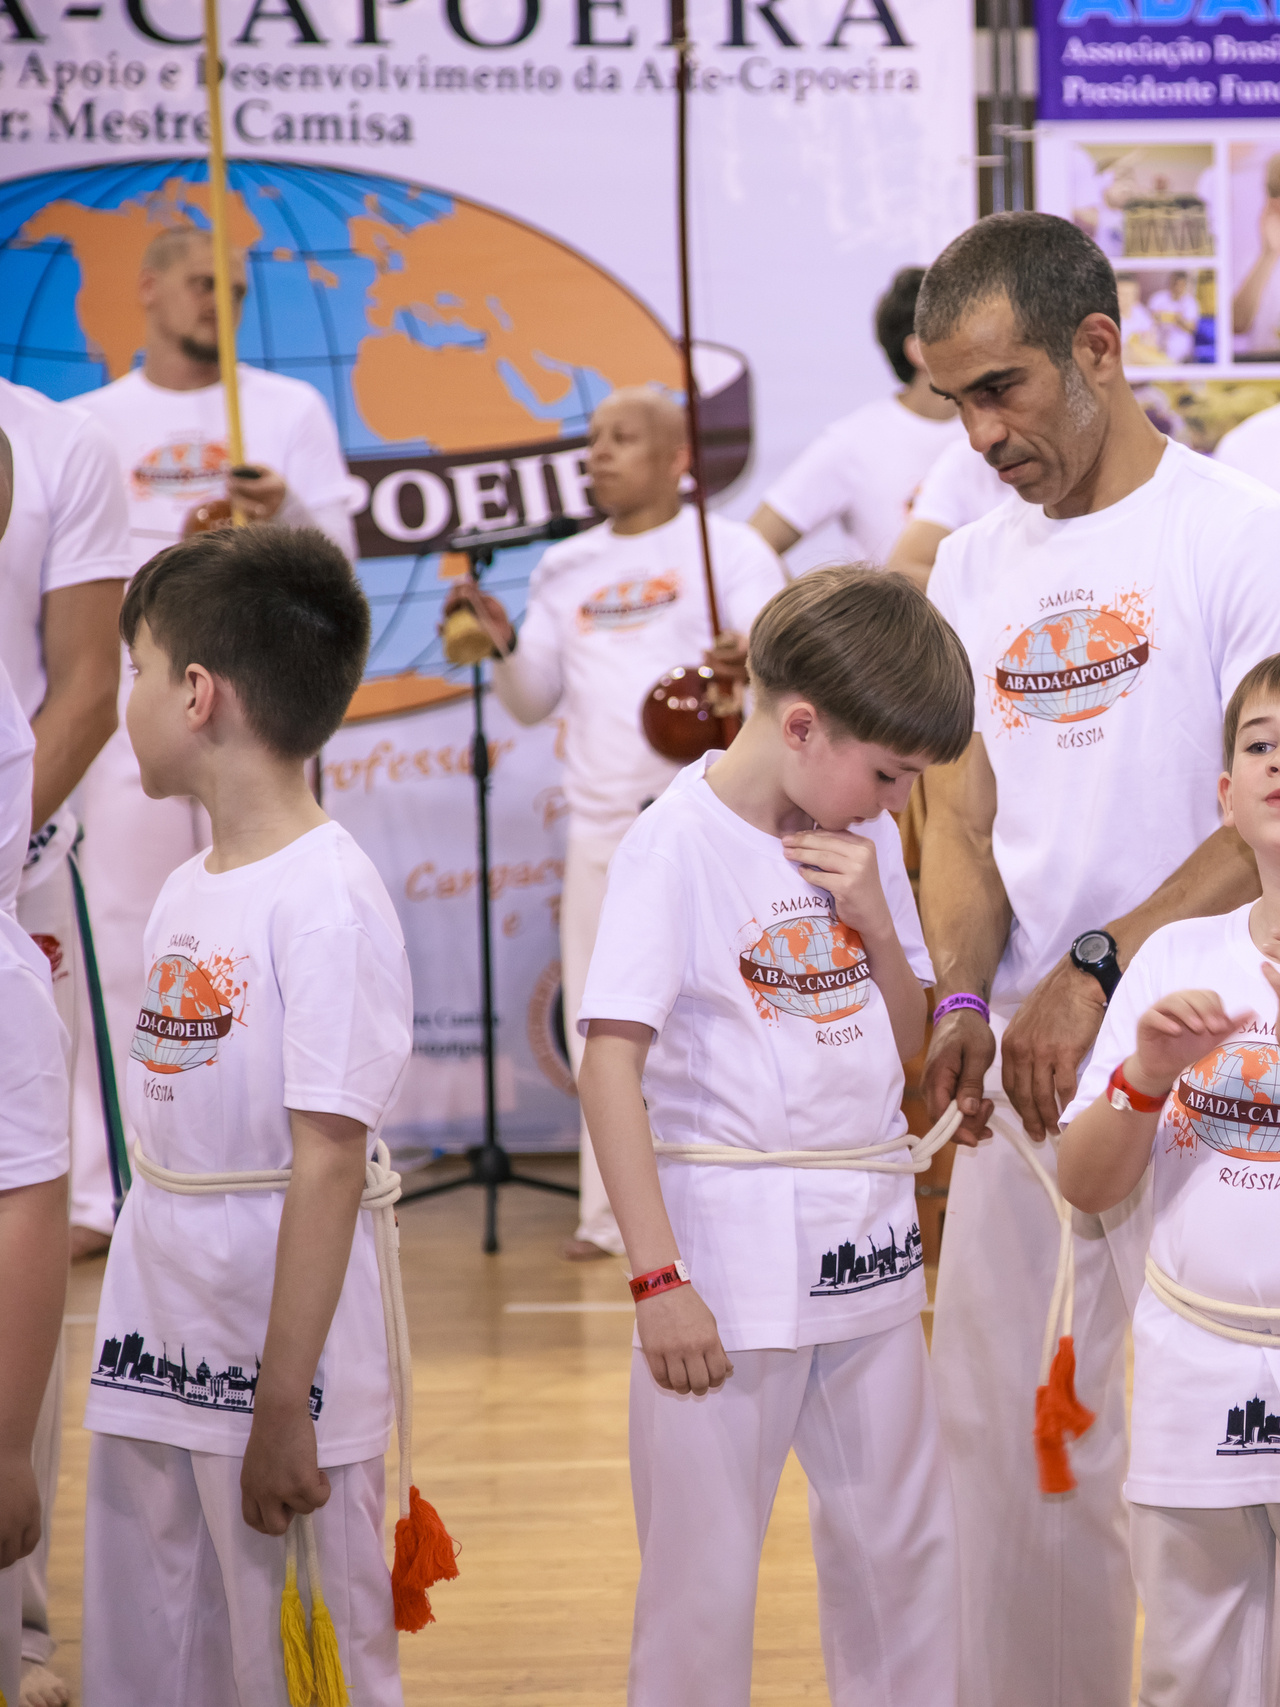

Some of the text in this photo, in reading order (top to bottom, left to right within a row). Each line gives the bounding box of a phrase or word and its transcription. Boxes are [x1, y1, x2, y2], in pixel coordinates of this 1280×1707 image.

[18, 50, 146, 97] Apoio
[159, 61, 180, 90] e
[574, 56, 621, 94] da
[233, 98, 413, 146] Camisa
[1004, 653, 1140, 691] ABADÁ-CAPOEIRA
[771, 896, 832, 916] SAMARA
[752, 963, 870, 991] ABAÁ-CAPOEIR
[816, 1024, 863, 1046] RÚSSIA
[143, 1078, 174, 1102] ÚSSIA
